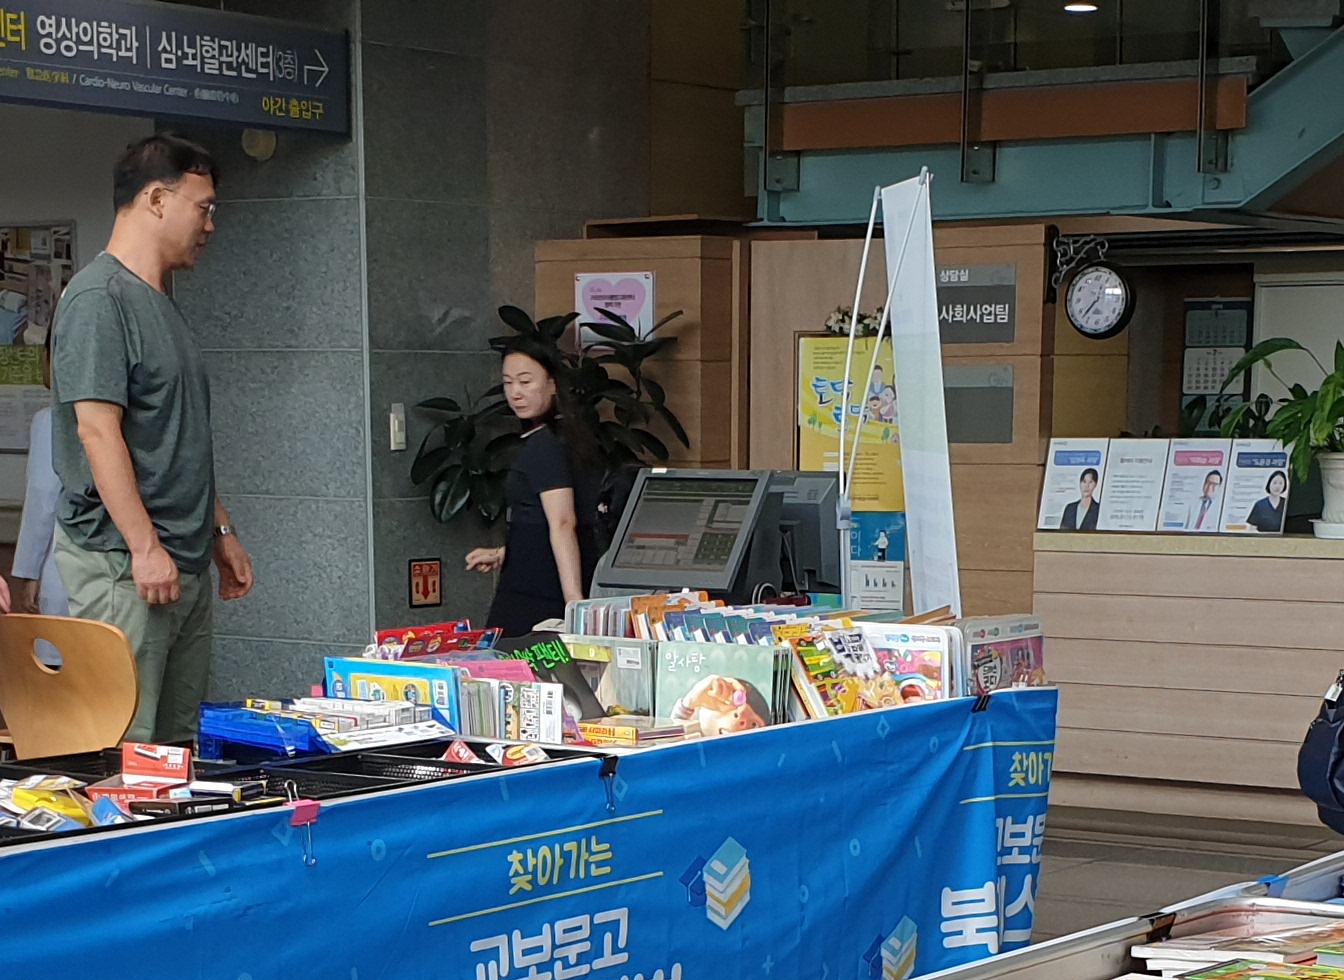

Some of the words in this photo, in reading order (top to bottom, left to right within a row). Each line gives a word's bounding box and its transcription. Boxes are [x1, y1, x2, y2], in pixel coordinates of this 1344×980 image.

[36, 14, 139, 65] 영상의학과
[262, 96, 286, 116] 야간
[288, 98, 325, 120] 출입구
[939, 269, 969, 282] 상담실
[938, 304, 1009, 325] 사회사업팀
[664, 650, 708, 673] 알사탕
[507, 834, 615, 895] 찾아가는
